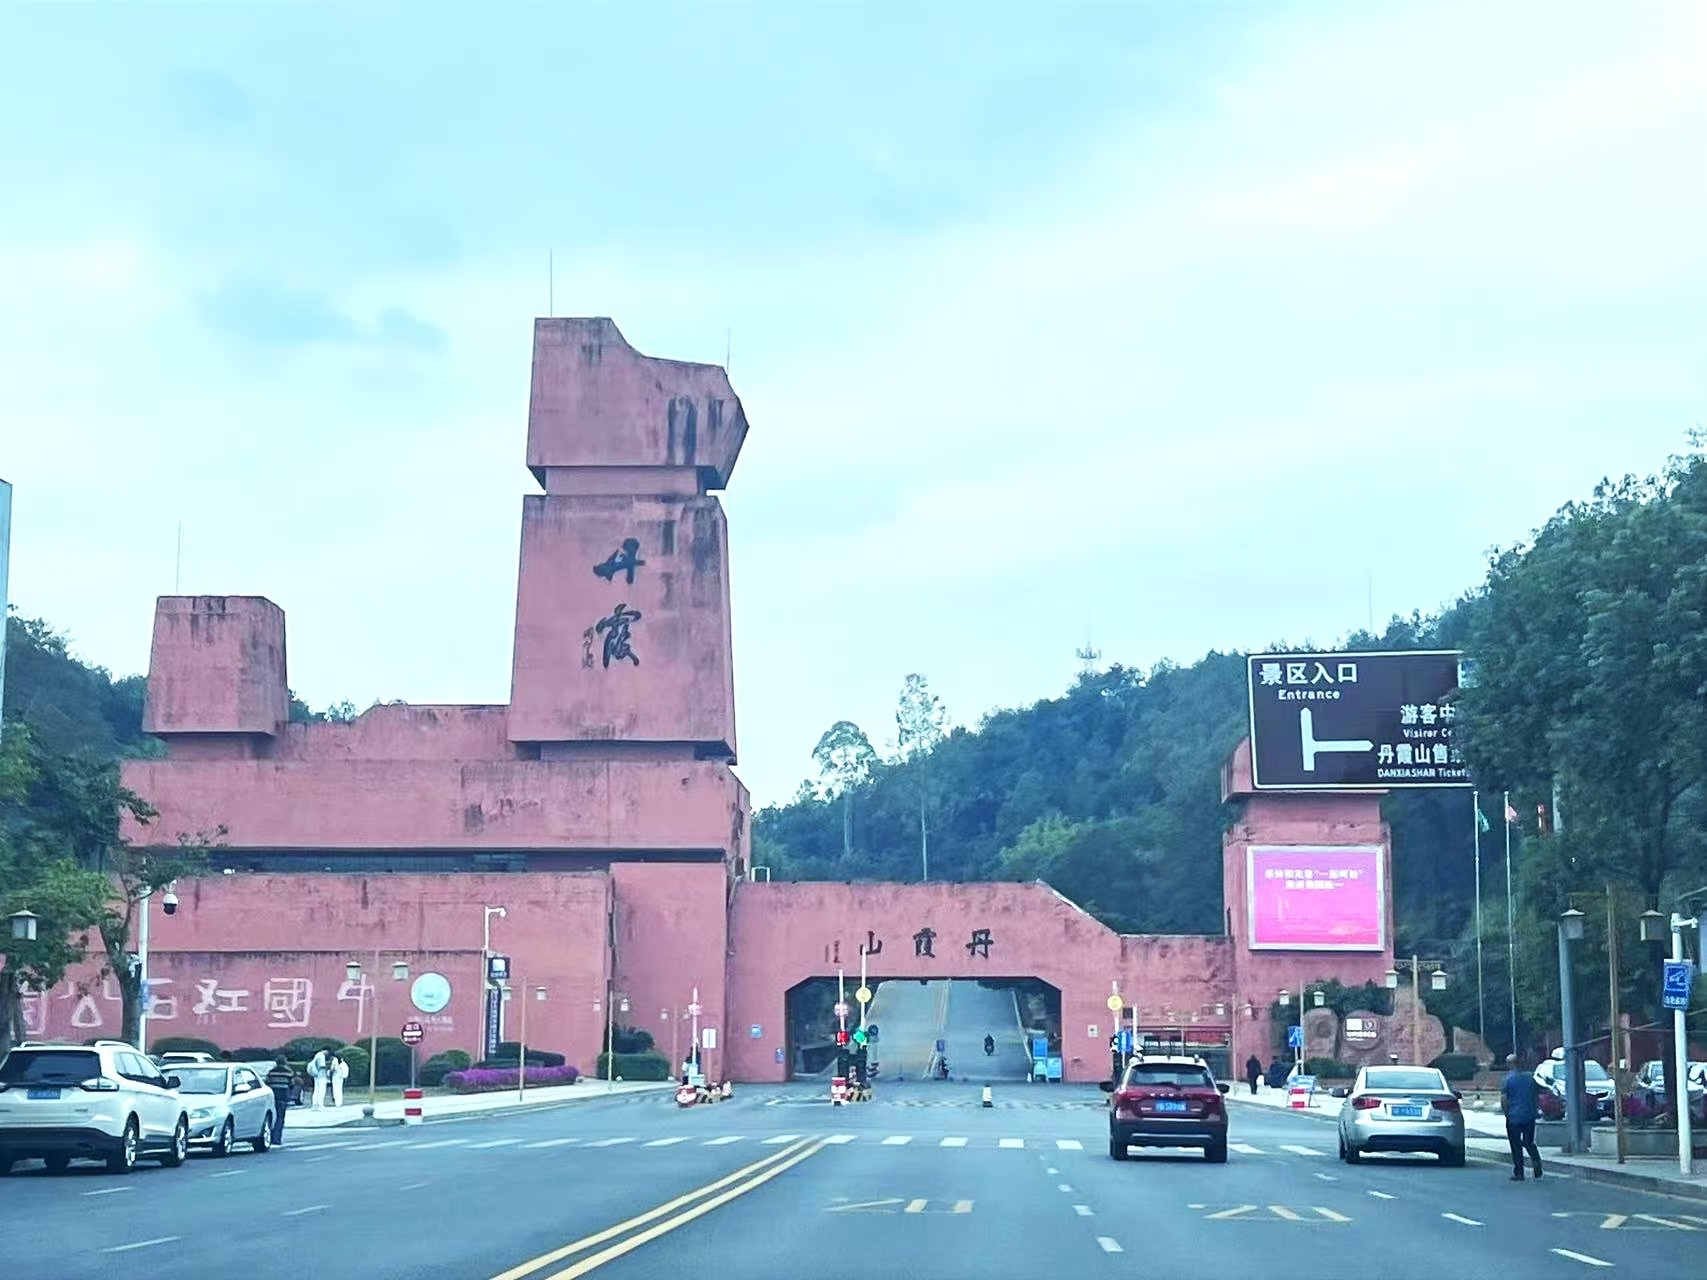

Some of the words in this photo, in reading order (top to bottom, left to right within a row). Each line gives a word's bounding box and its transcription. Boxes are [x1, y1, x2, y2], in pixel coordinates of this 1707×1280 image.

[592, 537, 646, 669] 丹霞
[1259, 662, 1357, 685] 景区入口
[1278, 689, 1340, 700] Entrance
[1377, 768, 1436, 778] DANXIASHAN
[859, 927, 994, 959] 丹霞山
